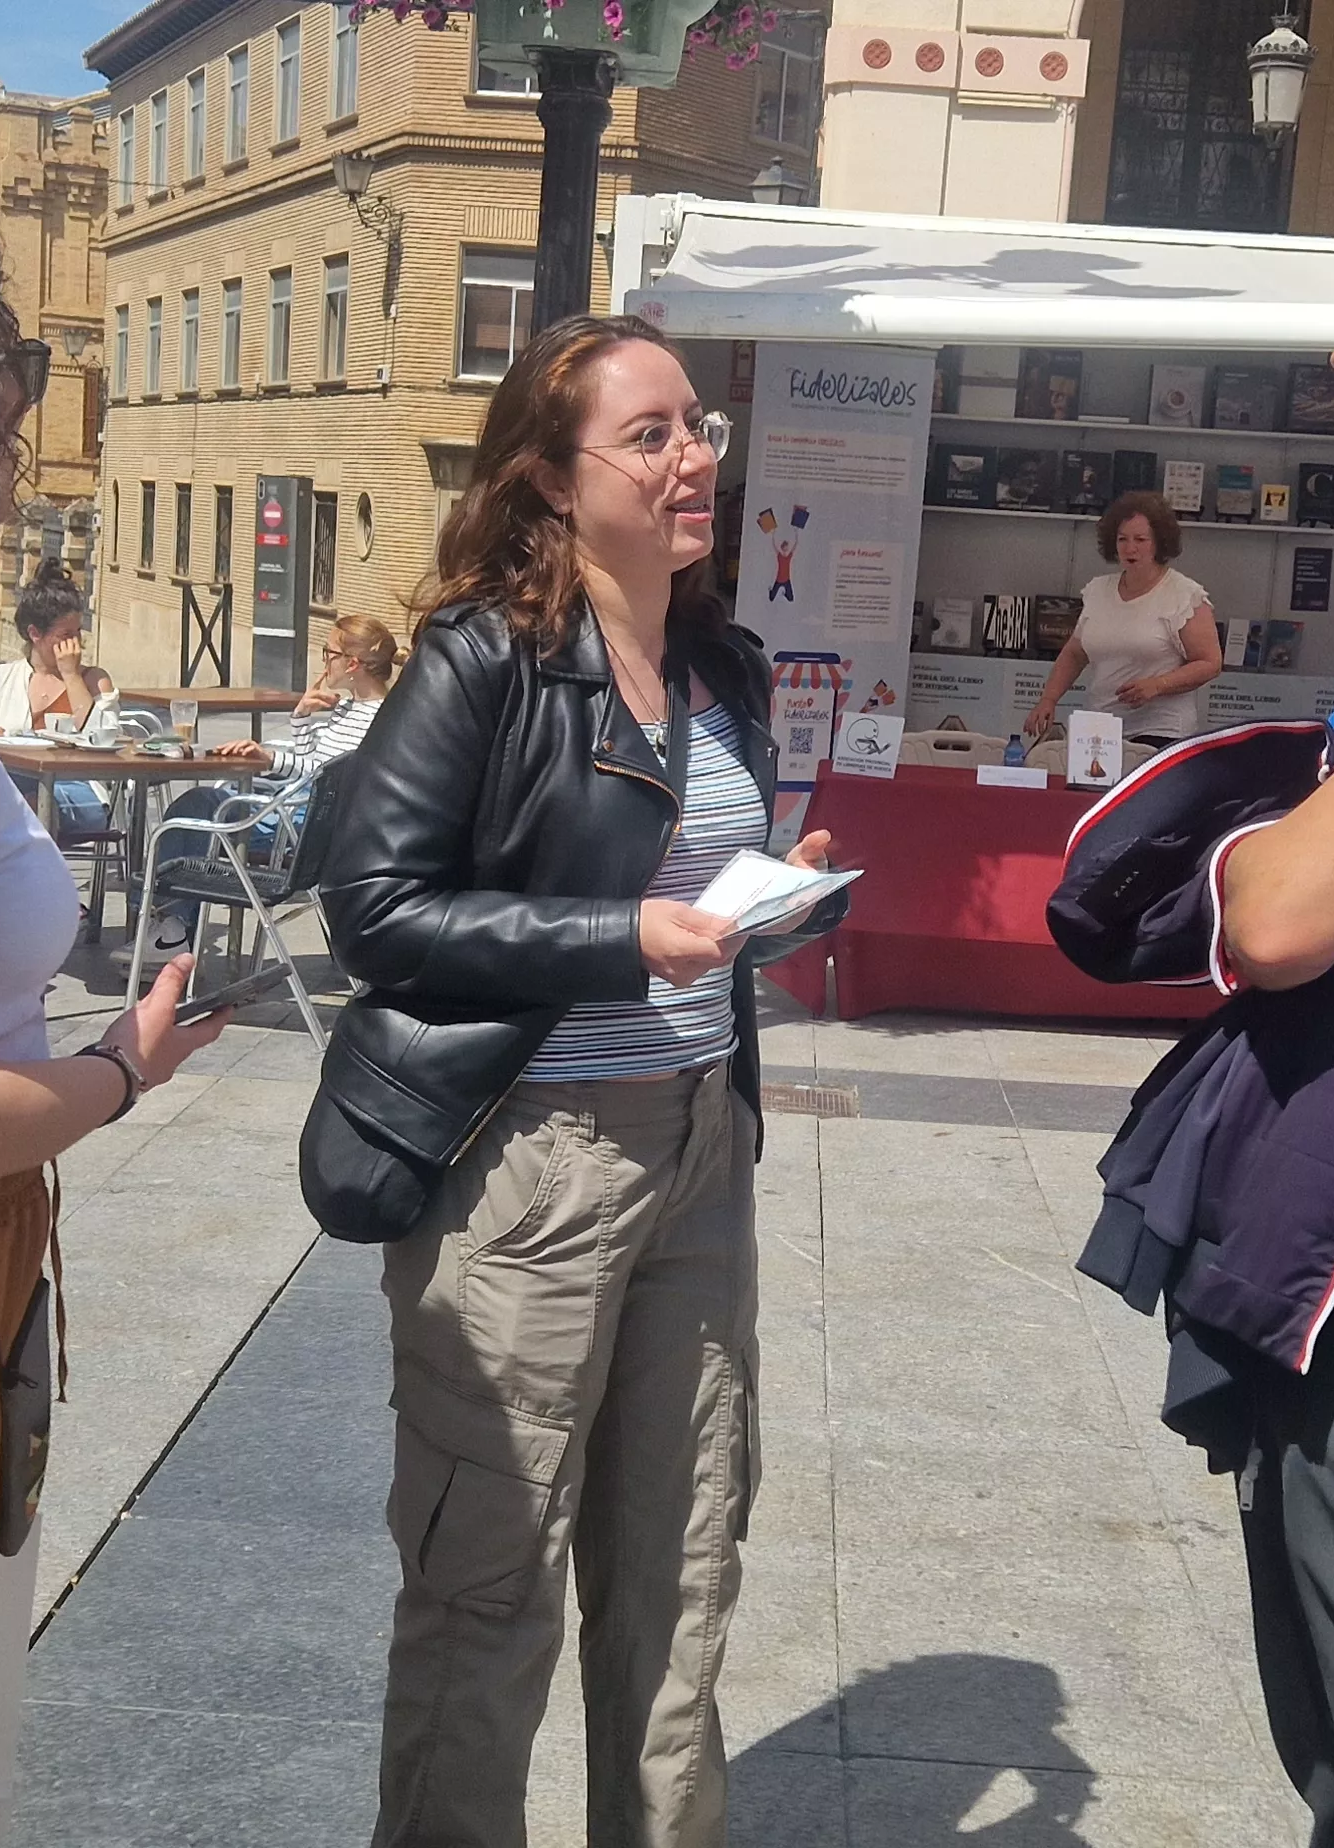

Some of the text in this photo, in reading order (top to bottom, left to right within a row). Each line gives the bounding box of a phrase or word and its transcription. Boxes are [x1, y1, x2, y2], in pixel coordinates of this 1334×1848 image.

[912, 673, 984, 685] FERIA DEL LIBRO
[924, 683, 959, 692] HUESCA
[1014, 680, 1041, 689] FERIA
[1014, 689, 1026, 697] DE
[1208, 693, 1281, 703] FERIA DEL LIBRO
[1208, 702, 1255, 711] DE HUESCA
